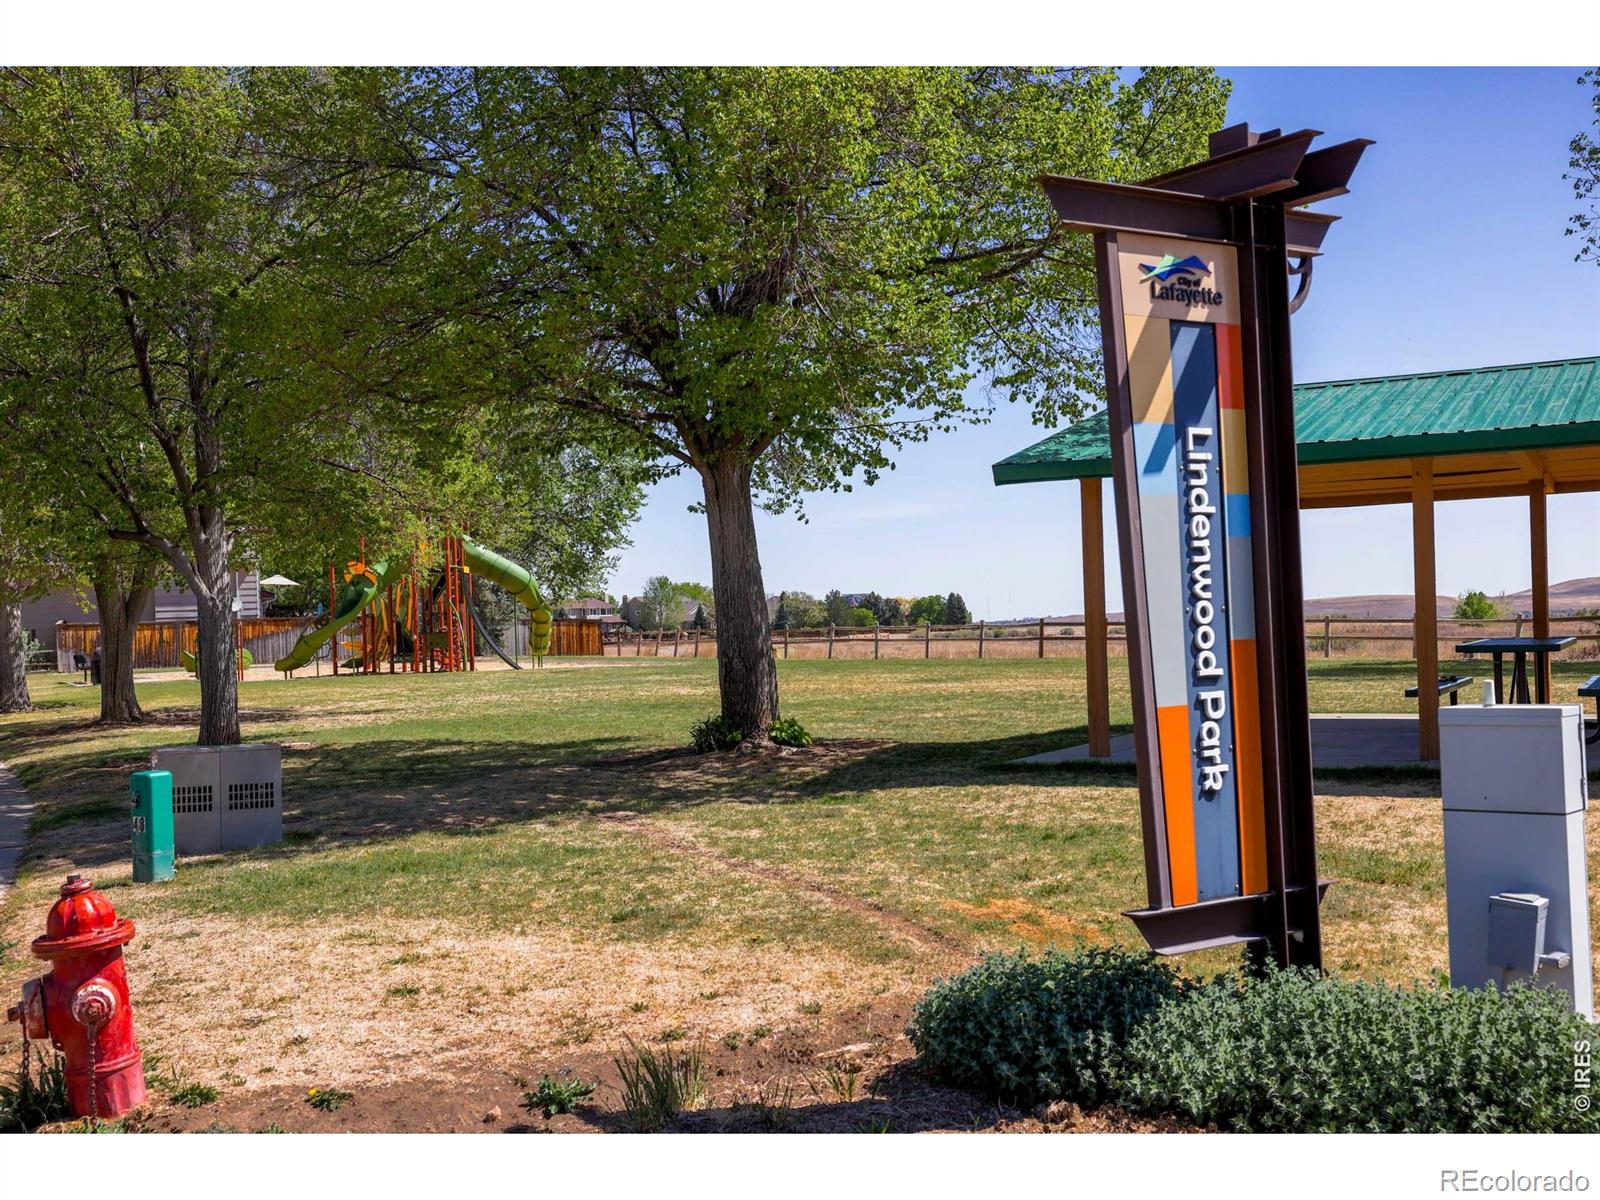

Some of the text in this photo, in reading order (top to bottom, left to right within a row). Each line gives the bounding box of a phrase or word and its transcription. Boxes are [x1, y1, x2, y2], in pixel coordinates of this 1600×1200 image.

[1150, 281, 1223, 306] Lafayette
[1186, 426, 1230, 791] Lindenwood Park
